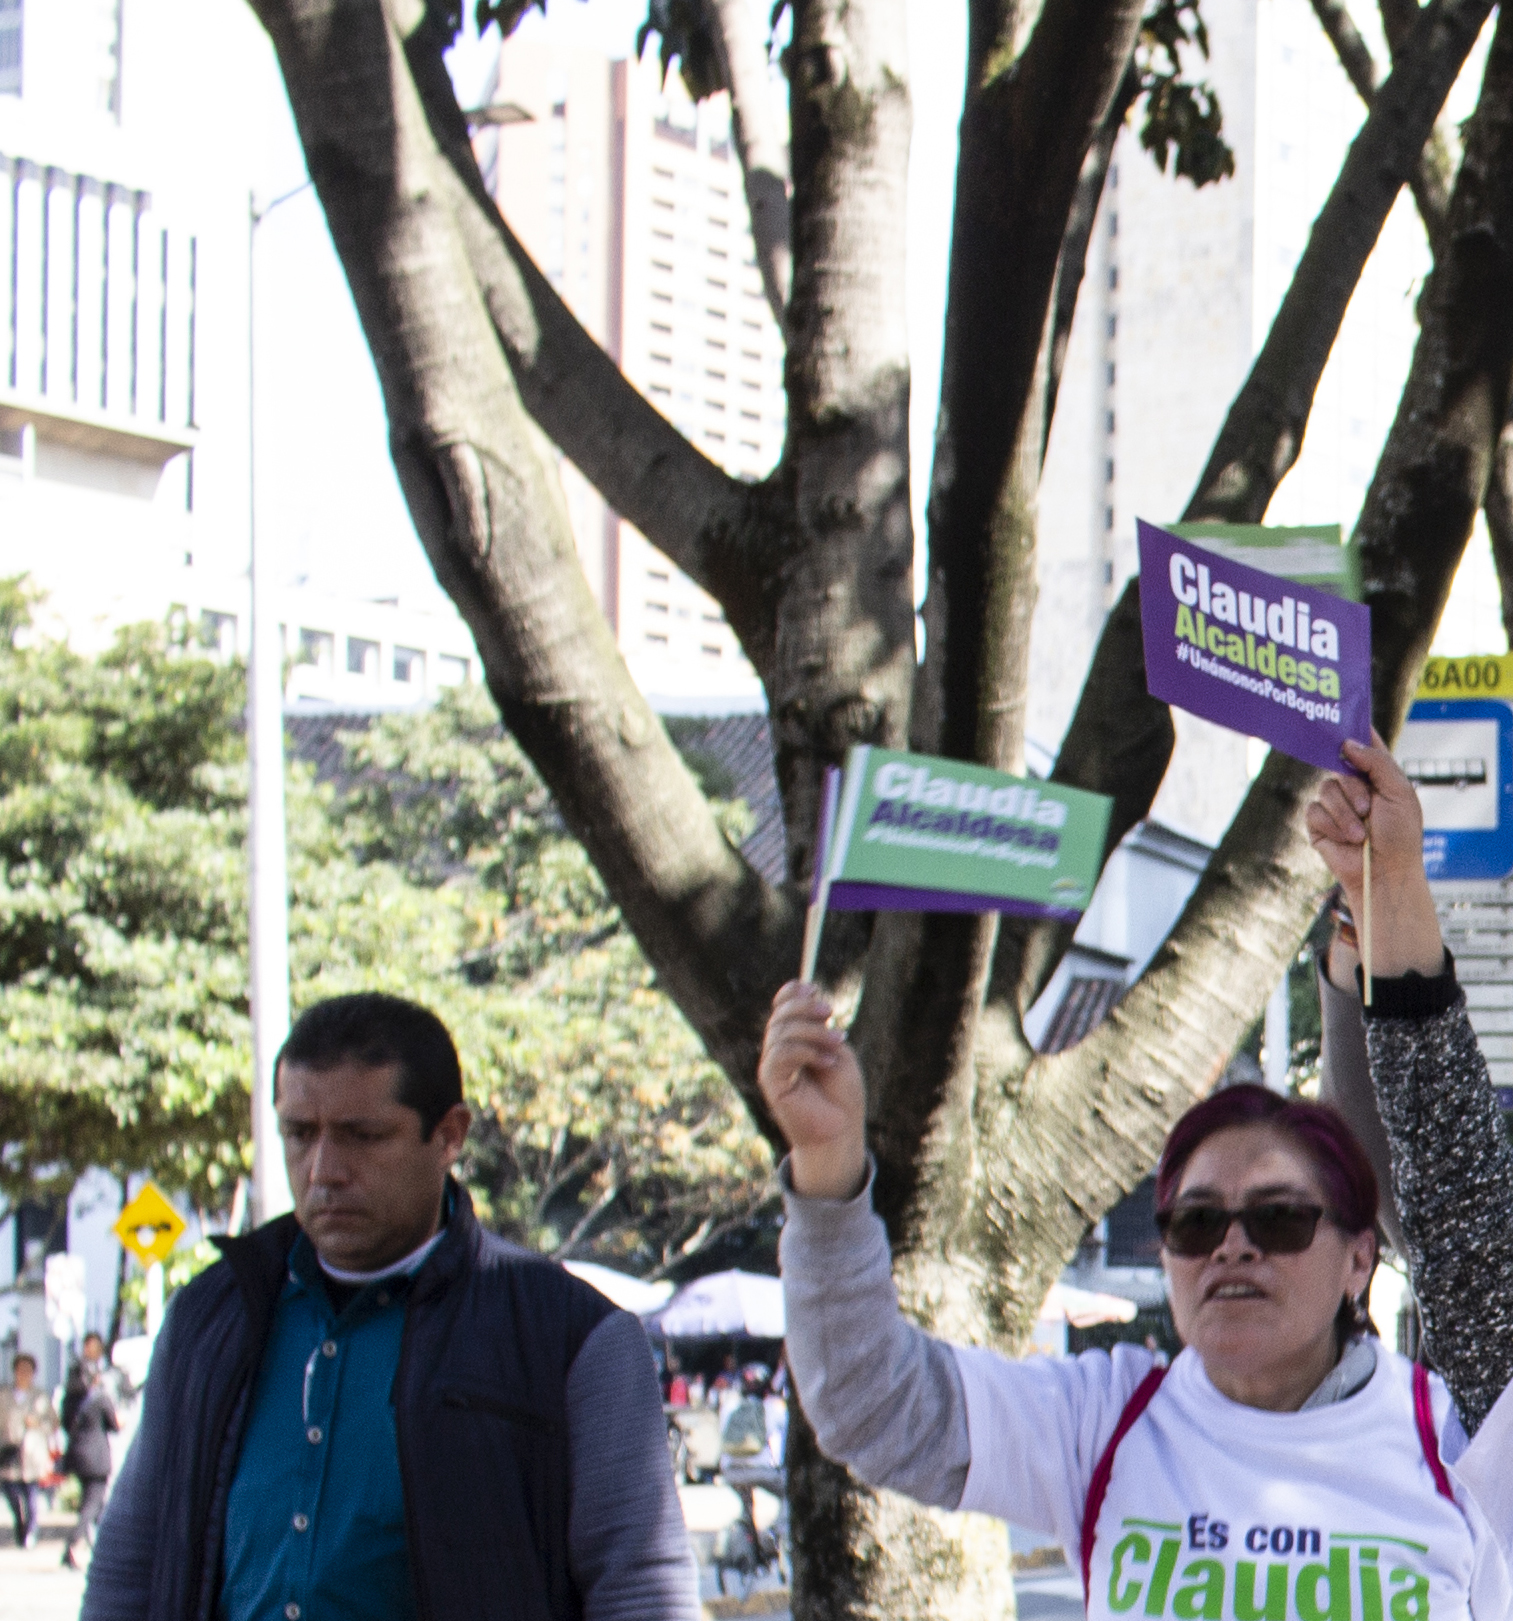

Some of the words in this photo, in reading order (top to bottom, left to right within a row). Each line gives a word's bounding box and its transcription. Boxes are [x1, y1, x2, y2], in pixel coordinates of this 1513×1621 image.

[1169, 552, 1340, 661] Claudia
[1175, 603, 1340, 699] Alcaldesa
[870, 800, 1060, 853] Alcaldesa
[872, 762, 1068, 828] Claudia
[1187, 1512, 1230, 1552] Es
[1245, 1525, 1322, 1556] con
